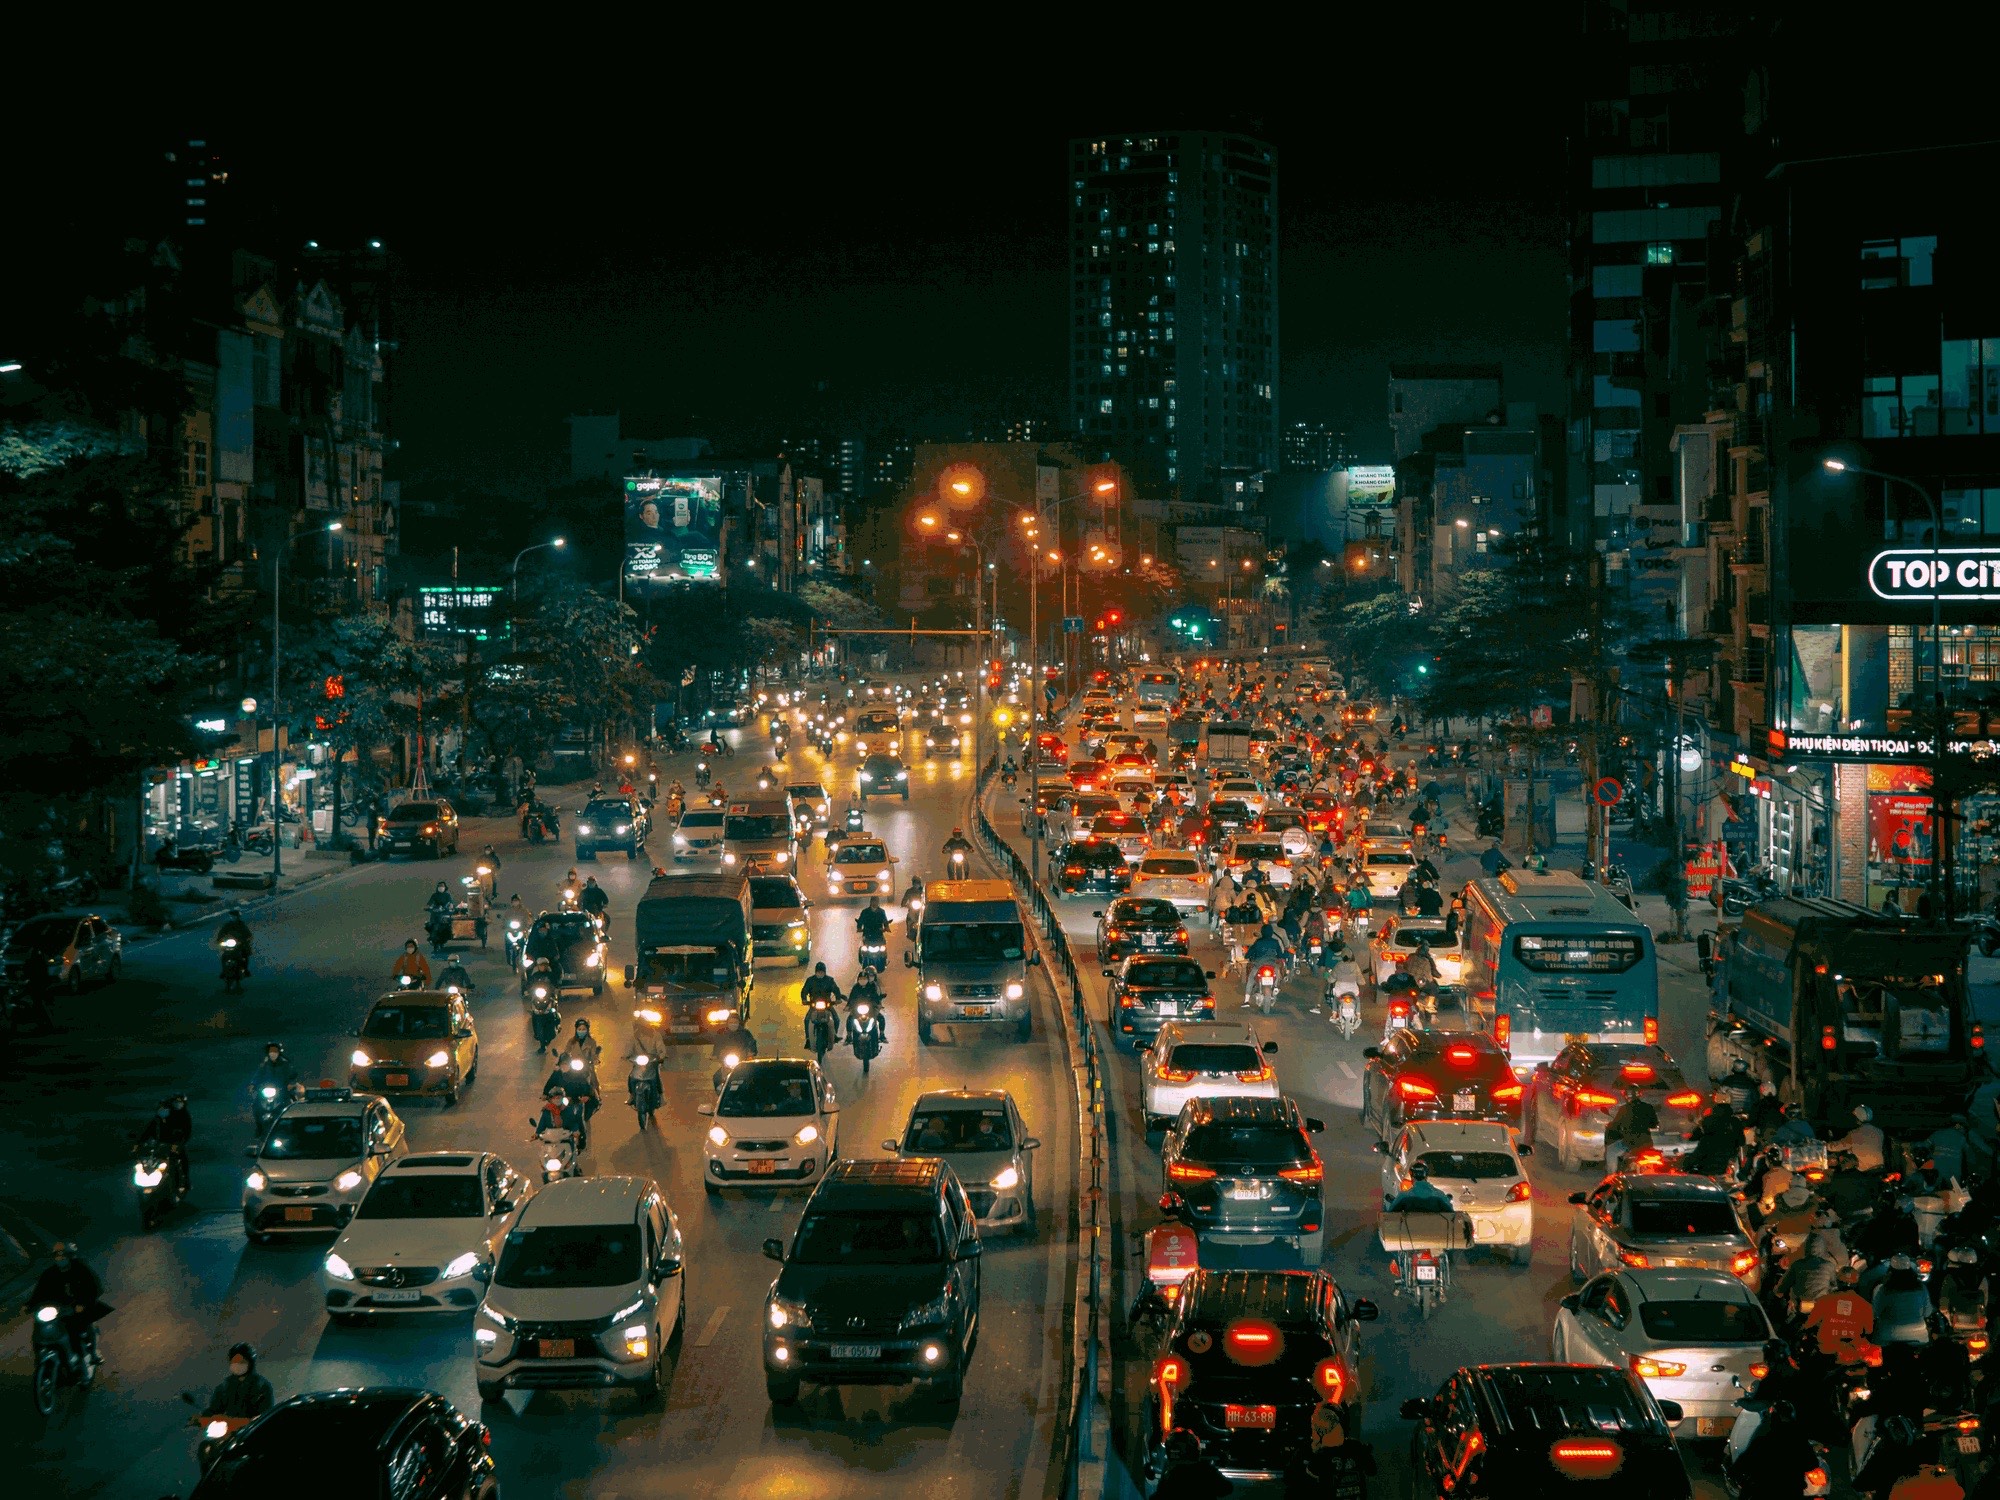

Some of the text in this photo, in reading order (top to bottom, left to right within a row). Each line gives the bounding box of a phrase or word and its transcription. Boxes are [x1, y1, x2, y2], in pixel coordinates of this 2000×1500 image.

[636, 482, 660, 491] gojek
[1886, 560, 1950, 588] TOP
[1788, 737, 1814, 754] PHỤ
[1814, 735, 1841, 754] KIỆN
[1841, 736, 1869, 755] ĐIỆN
[1870, 738, 1909, 757] THOẠI
